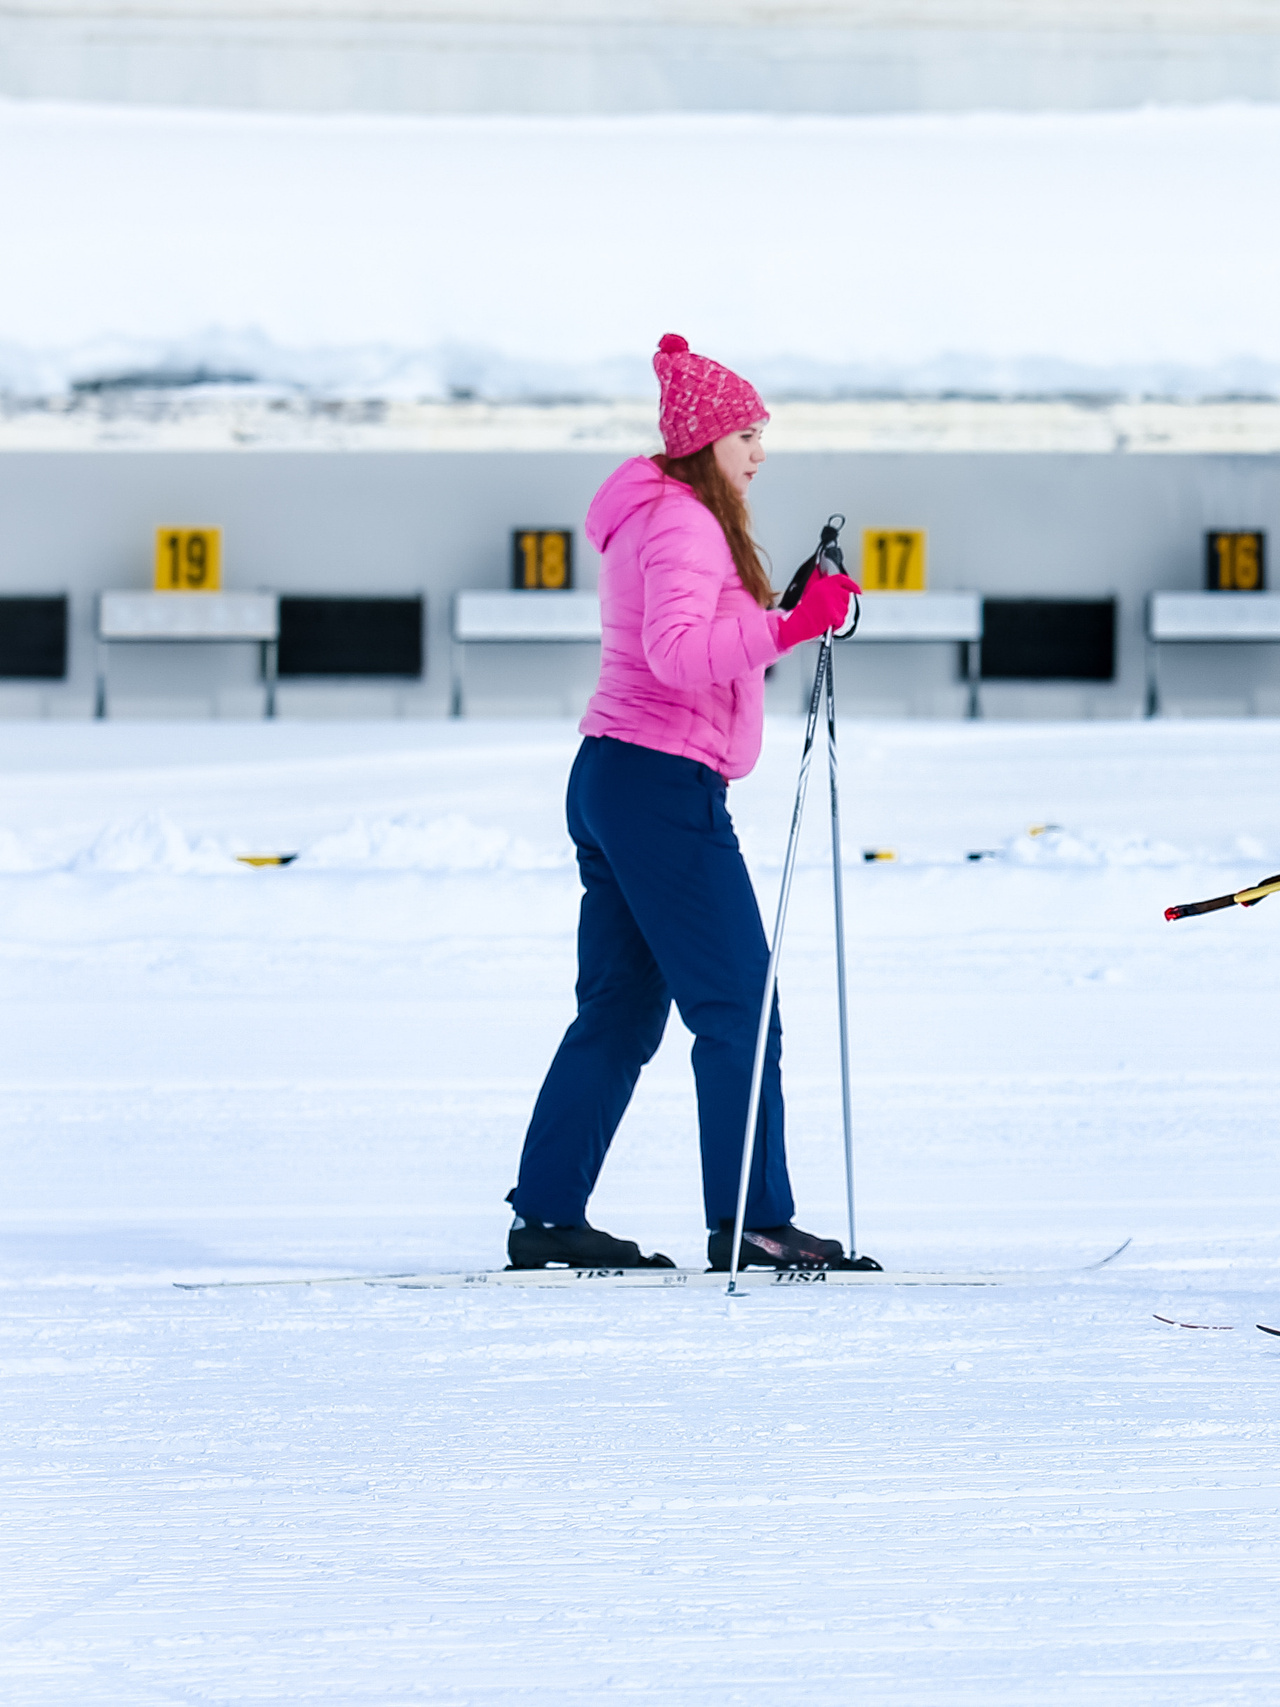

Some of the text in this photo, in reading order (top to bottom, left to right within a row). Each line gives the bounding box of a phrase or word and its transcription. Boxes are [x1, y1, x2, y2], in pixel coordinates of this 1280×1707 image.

[168, 533, 207, 588] 19
[521, 532, 565, 589] 18
[876, 533, 914, 589] 17
[774, 1272, 827, 1283] TISA
